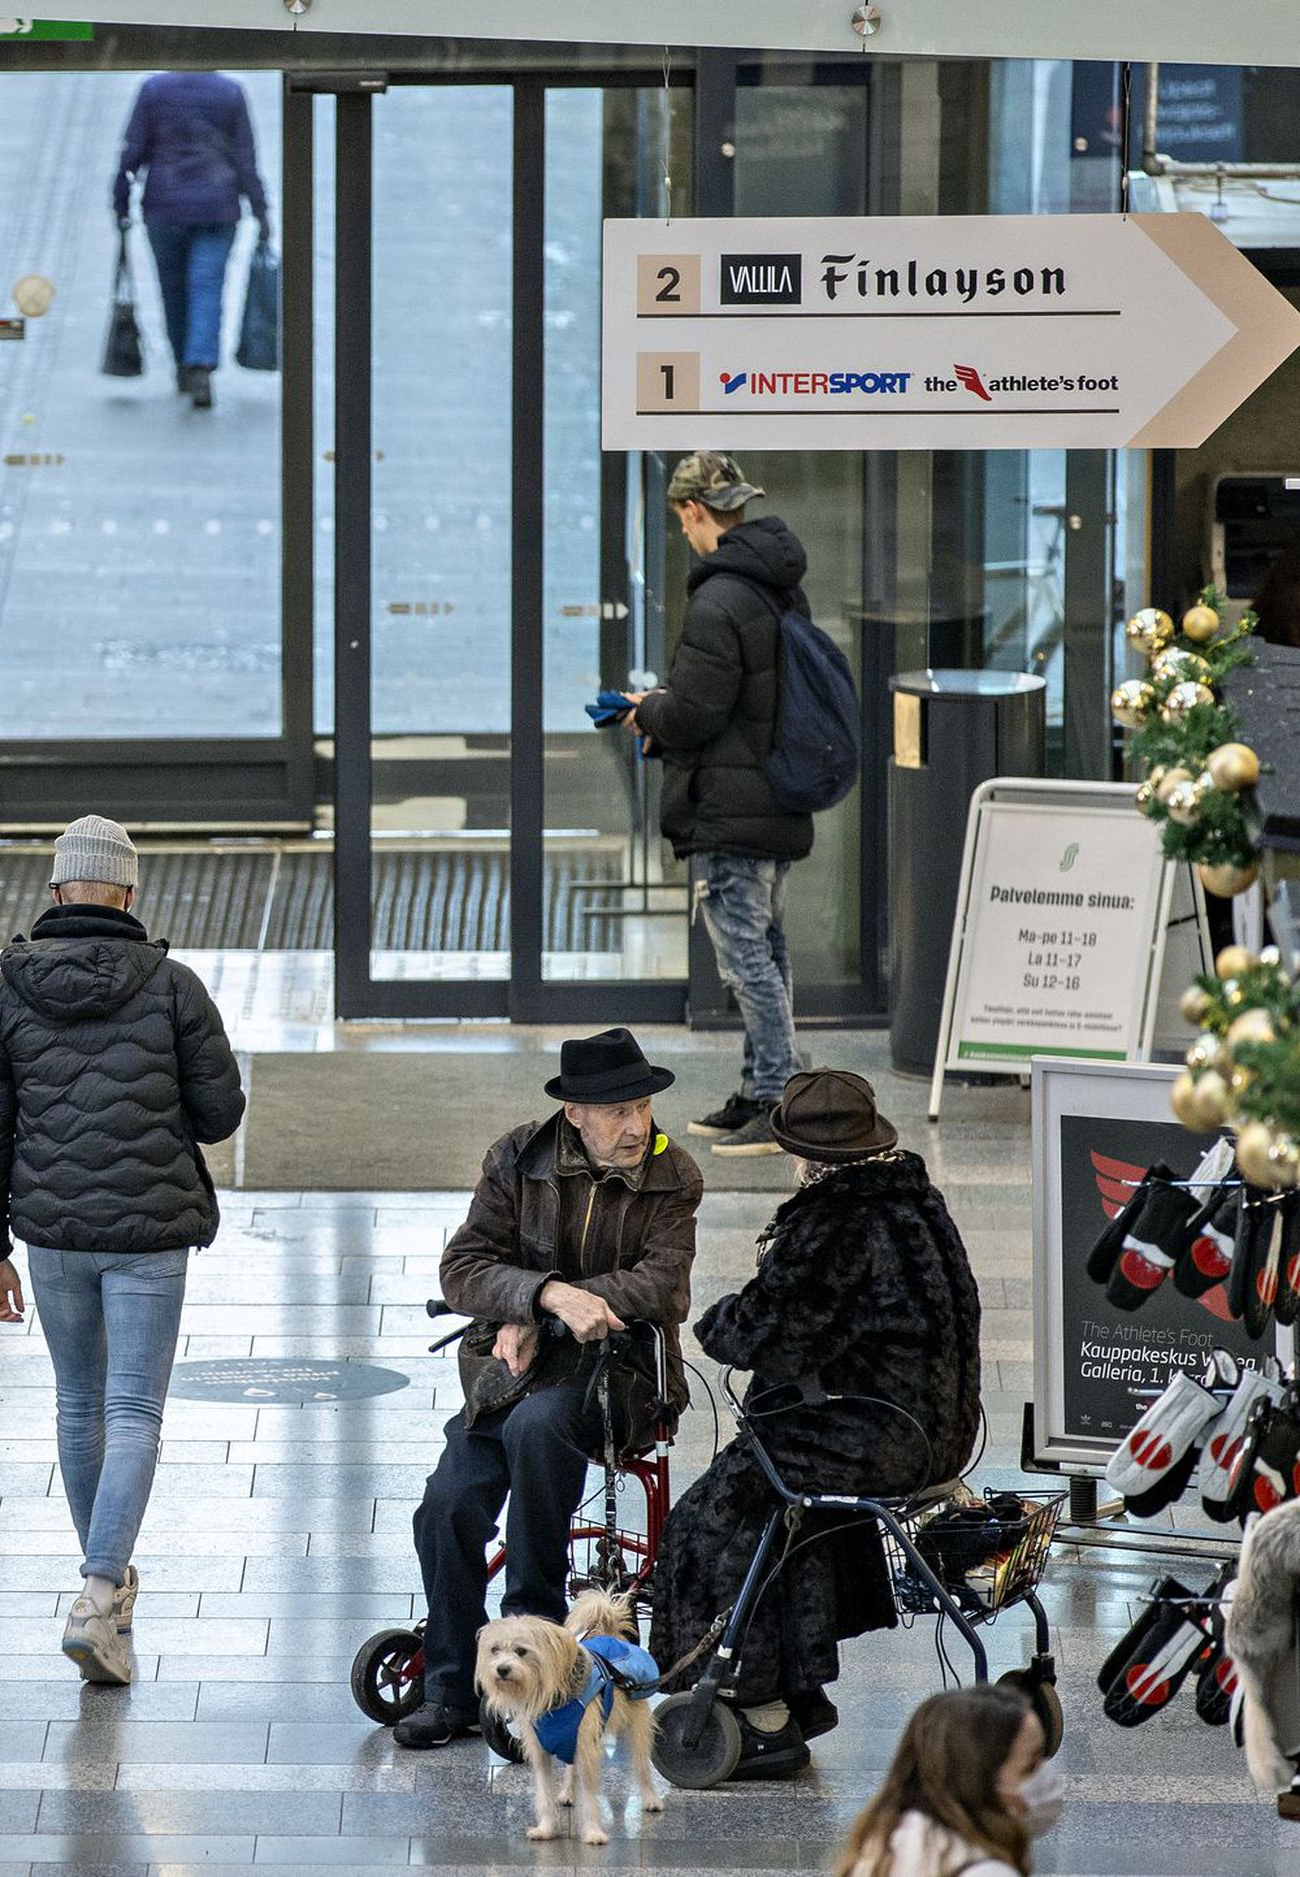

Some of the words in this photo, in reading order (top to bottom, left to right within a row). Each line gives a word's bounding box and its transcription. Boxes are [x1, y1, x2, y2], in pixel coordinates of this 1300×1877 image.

[654, 267, 682, 302] 2
[729, 265, 794, 294] VALLILA
[819, 253, 1067, 304] Finlayson
[659, 365, 675, 400] 1
[750, 372, 911, 395] INTERSPORT
[924, 375, 957, 393] the
[988, 374, 1074, 393] athlete's
[1076, 375, 1119, 393] foot
[990, 885, 1084, 909] Palvelemme
[1087, 890, 1135, 911] sinua:
[1018, 928, 1058, 946] Ma-pe
[1060, 930, 1097, 947] 11-18
[1027, 952, 1042, 967] La
[1045, 953, 1082, 968] 11-17
[1023, 975, 1039, 989] Su
[1082, 1320, 1108, 1339] The
[1111, 1324, 1176, 1345] Athlete's
[1179, 1329, 1214, 1348] Foot
[1080, 1341, 1198, 1367] Kauppakeskus
[1080, 1362, 1146, 1384] Galleria,
[1150, 1367, 1164, 1384] 1.
